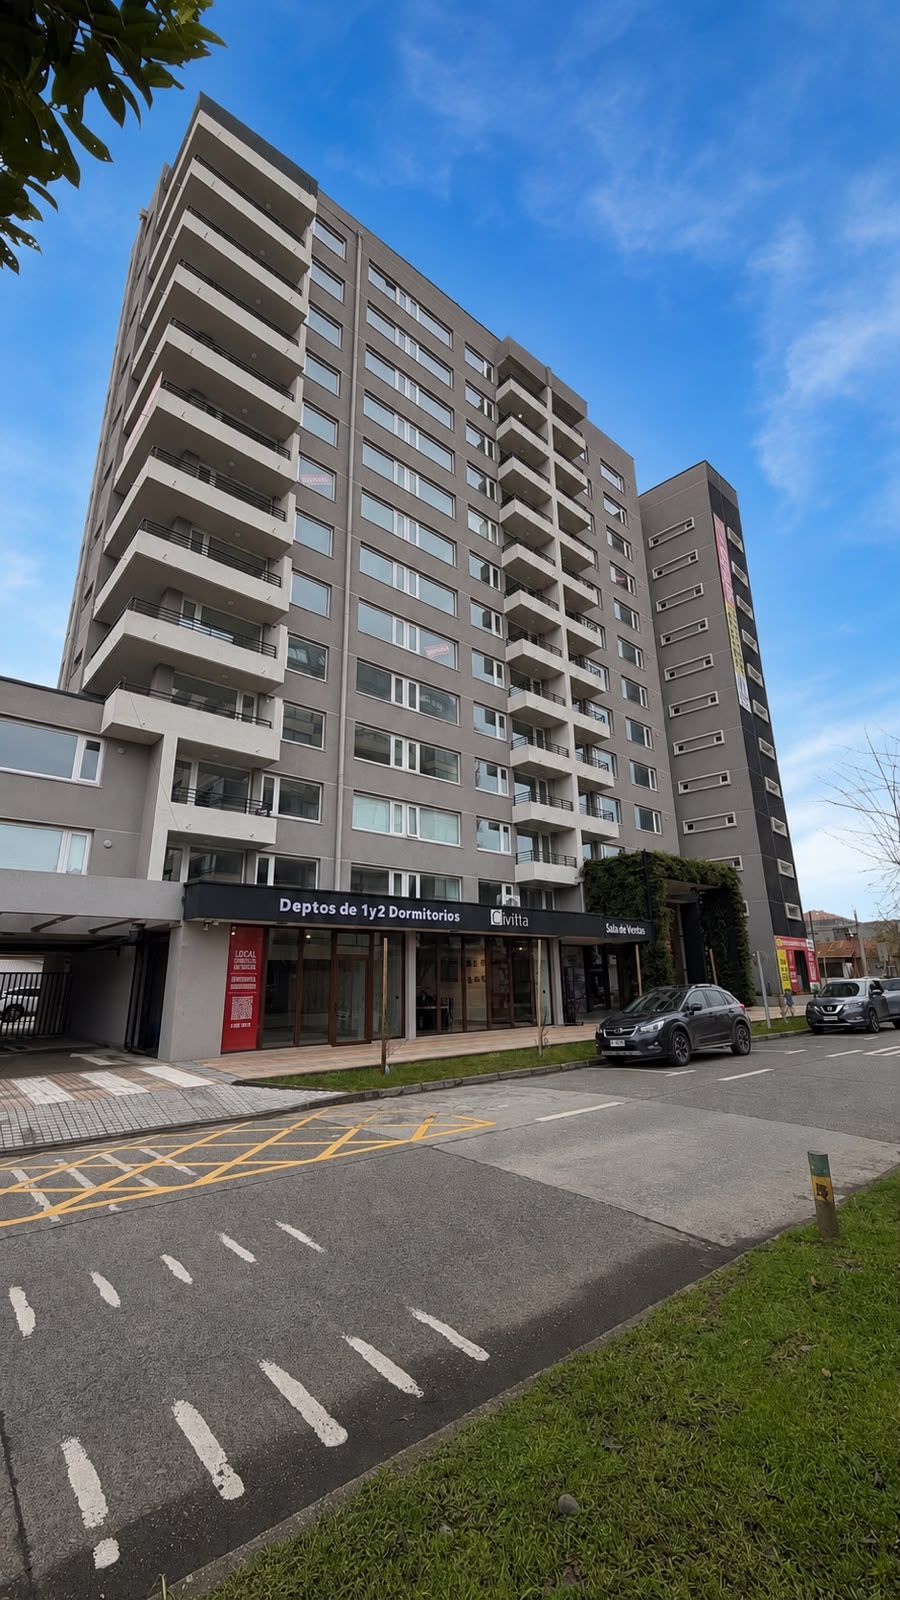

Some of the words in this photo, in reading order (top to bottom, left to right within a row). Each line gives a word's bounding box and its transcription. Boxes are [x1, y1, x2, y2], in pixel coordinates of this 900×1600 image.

[279, 898, 336, 916] Deptos
[339, 902, 357, 915] de
[389, 905, 460, 922] Dormitorios
[490, 909, 529, 927] Civitta
[606, 923, 618, 934] Sala
[618, 924, 627, 934] de
[627, 925, 645, 936] Ventas
[235, 950, 256, 958] LOCAL
